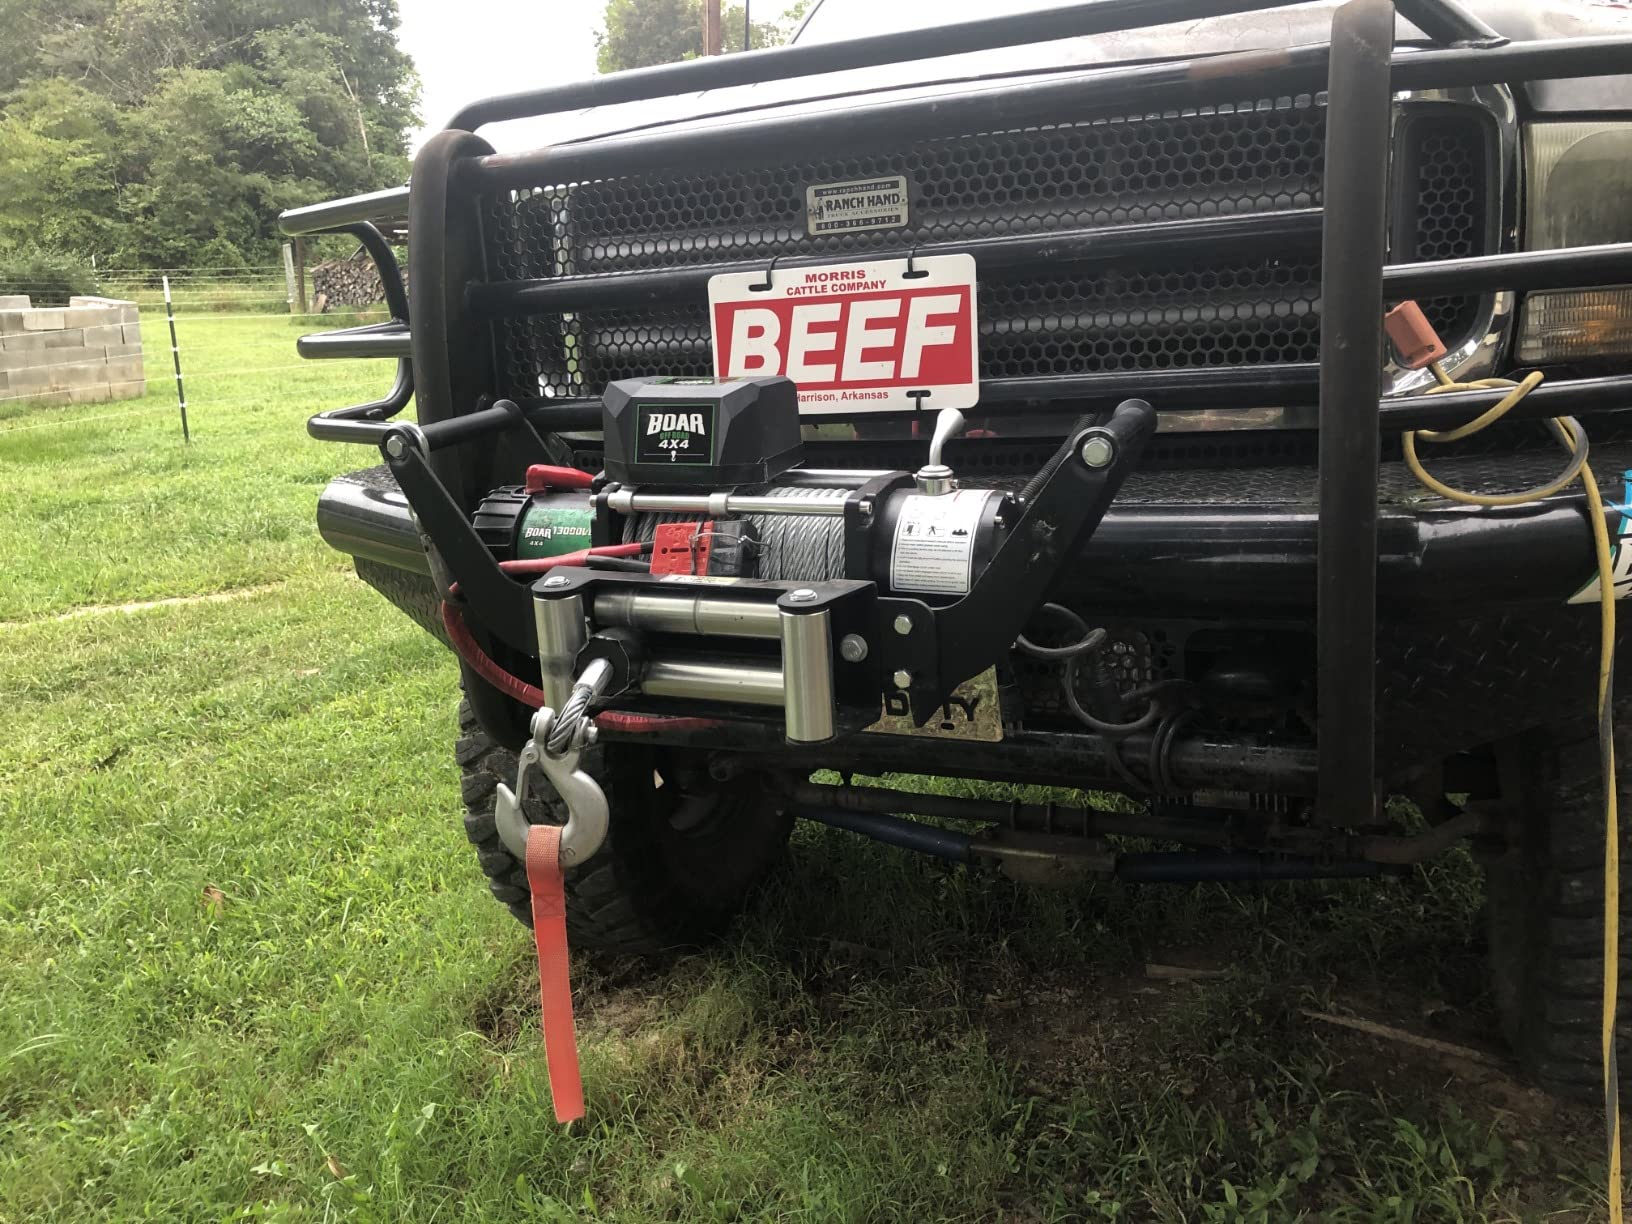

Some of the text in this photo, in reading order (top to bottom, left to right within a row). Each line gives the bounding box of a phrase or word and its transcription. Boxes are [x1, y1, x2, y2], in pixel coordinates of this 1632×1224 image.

[825, 193, 901, 212] RANCH HAND
[805, 270, 866, 283] MORRIS
[786, 280, 887, 296] CATTLE COMPANY
[728, 294, 962, 382] BEEF
[841, 391, 889, 401] Arkansas
[646, 413, 706, 436] BOAR
[658, 439, 690, 449] 4X4
[525, 527, 552, 539] BOAR
[884, 691, 980, 722] DTY
